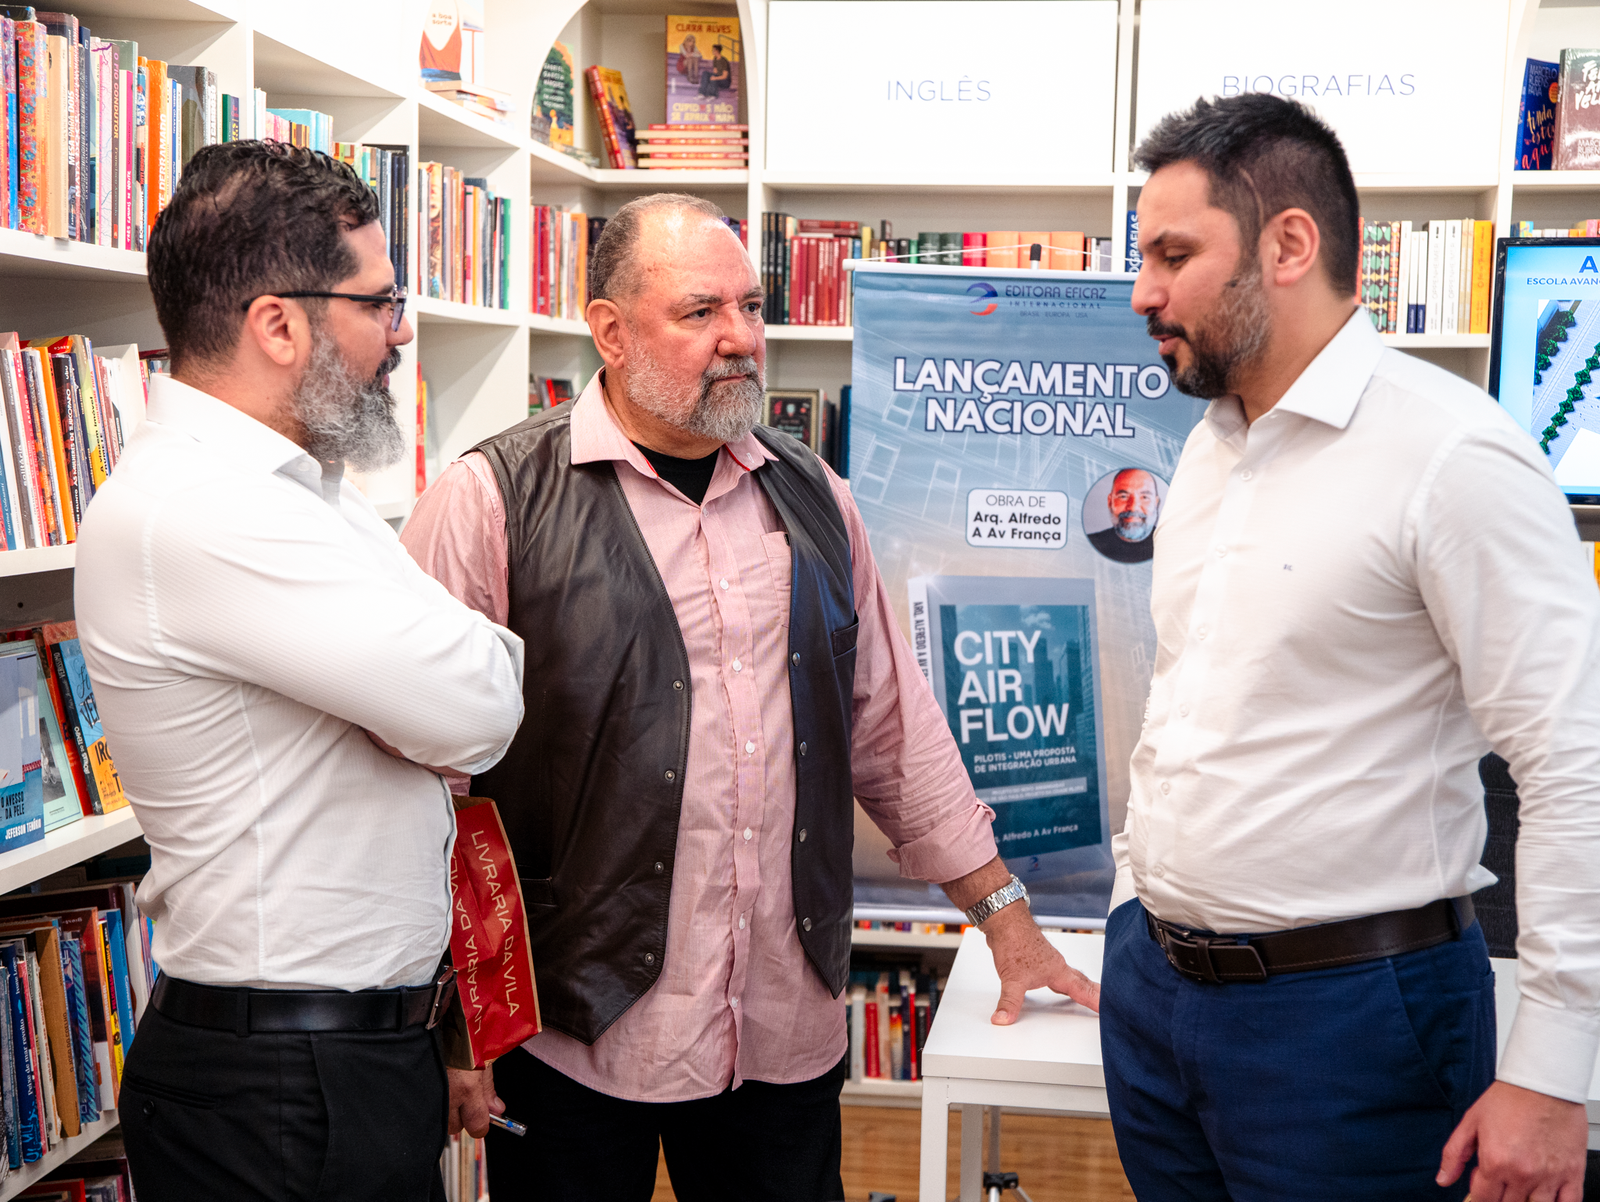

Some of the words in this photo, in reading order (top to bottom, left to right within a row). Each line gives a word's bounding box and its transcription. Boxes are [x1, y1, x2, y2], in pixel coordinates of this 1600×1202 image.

[676, 23, 702, 33] CLARA
[706, 24, 732, 34] ALVES
[113, 52, 119, 60] O
[543, 63, 564, 73] GABRIEL
[887, 75, 992, 101] INGLÊS
[1223, 74, 1416, 97] BIOGRAFIAS
[714, 102, 734, 113] NÃO
[671, 113, 681, 121] SE
[159, 113, 167, 191] DERRAMADO
[1579, 255, 1599, 273] A
[1526, 277, 1568, 285] ESCOLA
[1570, 277, 1600, 285] AVAN
[1005, 284, 1061, 298] EDITORA
[1065, 287, 1107, 300] EFICAZ
[1009, 301, 1102, 309] INTERNACIONAL
[894, 357, 1170, 404] LANÇAMENTO
[89, 396, 97, 427] imóvel
[925, 398, 1135, 438] NACIONAL
[69, 432, 75, 442] DE
[73, 476, 78, 486] AS
[986, 494, 1025, 507] OBRA
[1028, 495, 1046, 508] DE
[973, 511, 1003, 526] Arq.
[1008, 512, 1061, 525] Alfredo
[972, 526, 982, 538] A
[987, 527, 1006, 538] Av
[1011, 528, 1061, 543] França
[913, 601, 924, 618] ARQ.
[914, 619, 927, 650] ALFREDO
[954, 630, 1041, 666] CITY
[958, 669, 1022, 705] AIR
[959, 703, 1069, 744] FLOW
[974, 753, 1007, 763] PILOTIS
[1013, 750, 1032, 760] UMA
[1033, 746, 1076, 757] PROPOSTA
[974, 764, 987, 774] DE
[988, 758, 1042, 771] INTEGRAÇÃO
[1043, 755, 1077, 766] URBANA
[1, 796, 5, 808] O
[6, 791, 24, 807] AVESSO
[5, 807, 12, 820] DA
[13, 803, 25, 818] PELE
[5, 824, 26, 840] JEFERSON
[1002, 830, 1032, 842] Alfredo
[1033, 829, 1040, 837] A
[1041, 828, 1051, 836] Av
[1053, 824, 1079, 834] França
[471, 829, 513, 934] LIVRARIA
[456, 897, 472, 931] DA
[502, 935, 514, 966] DA
[109, 974, 117, 1010] FELICIDADE
[465, 934, 483, 1035] LIVRARIA
[503, 965, 520, 1018] VILA
[19, 1018, 28, 1044] revolto
[22, 1046, 30, 1062] mar
[25, 1063, 31, 1074] de
